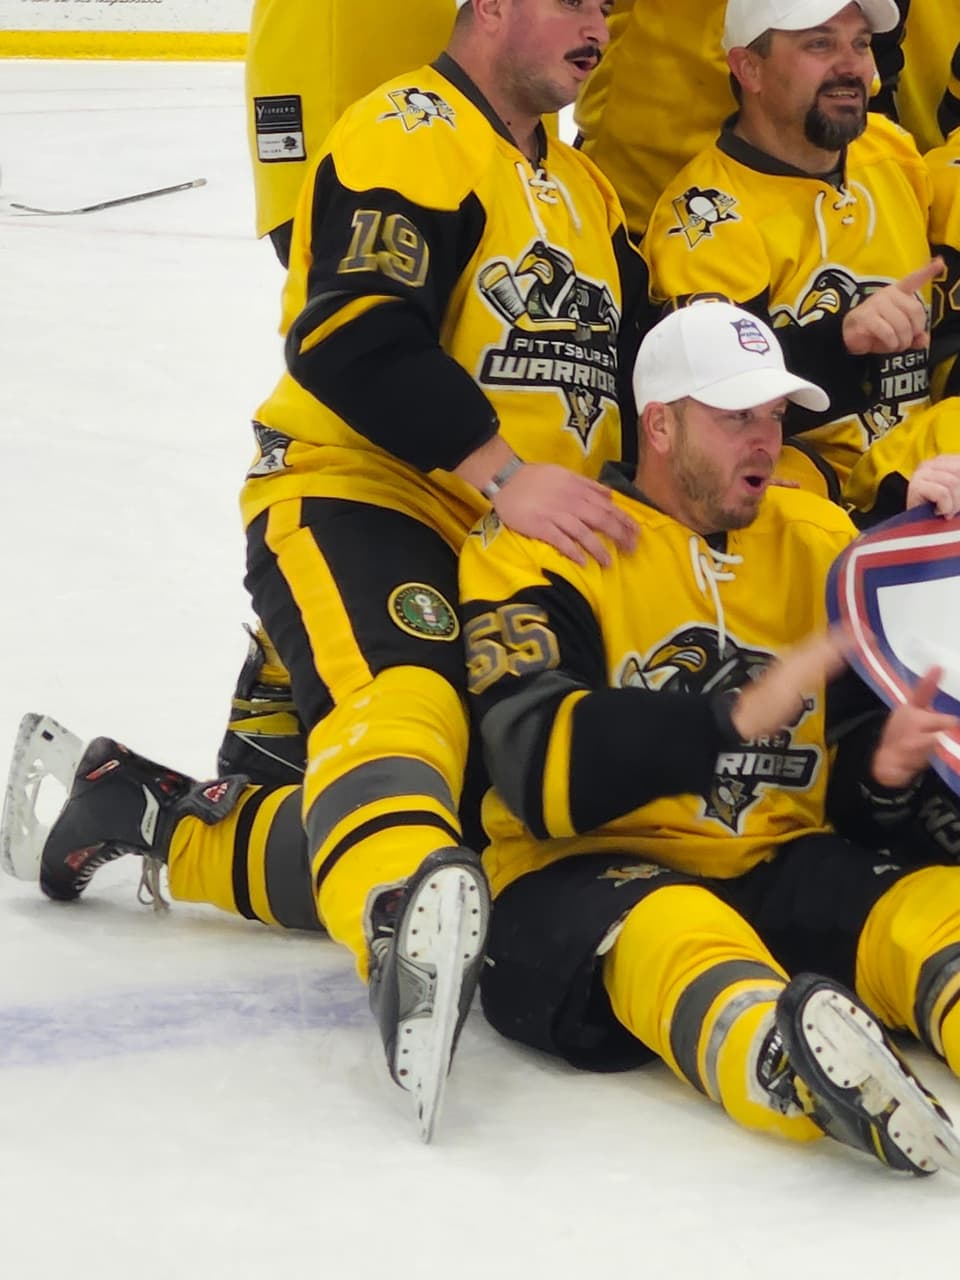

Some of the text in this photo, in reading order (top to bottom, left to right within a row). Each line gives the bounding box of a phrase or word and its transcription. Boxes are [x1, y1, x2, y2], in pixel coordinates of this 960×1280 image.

[337, 209, 430, 288] 19
[488, 355, 616, 394] WARRIOR
[513, 337, 614, 367] PITTSBURG
[463, 604, 560, 695] 55
